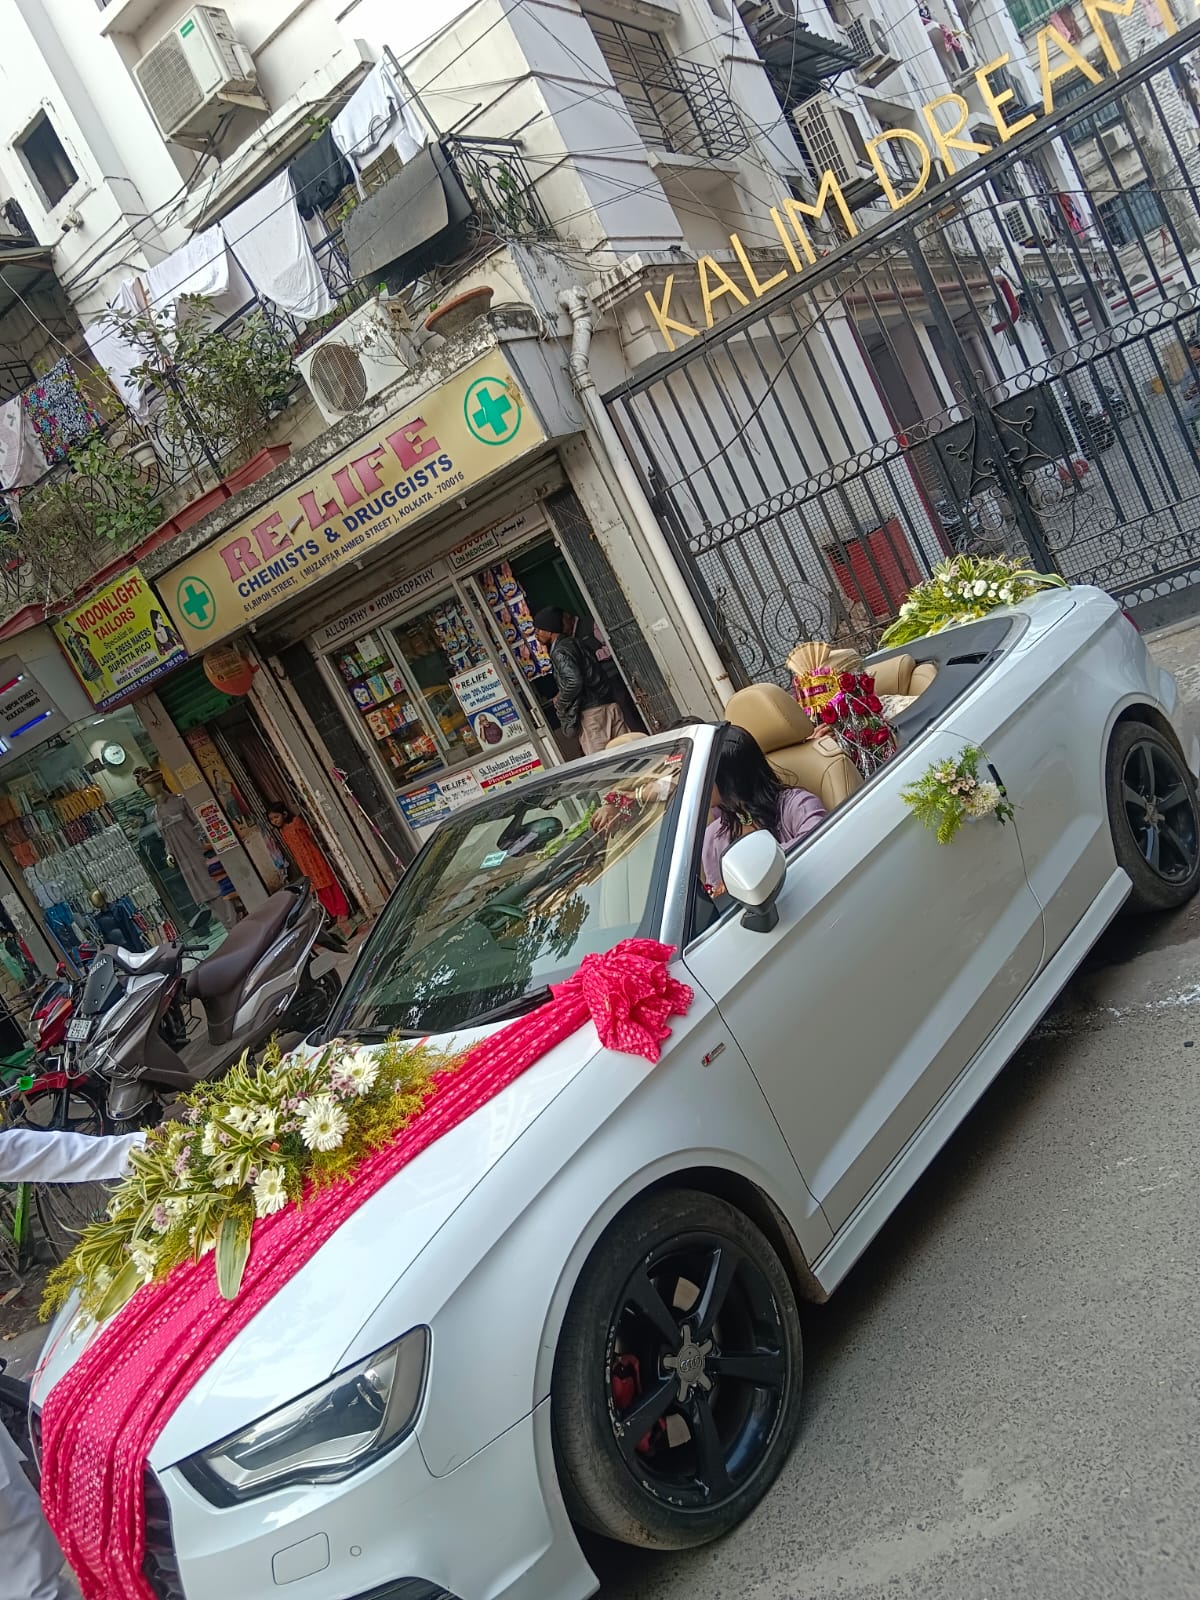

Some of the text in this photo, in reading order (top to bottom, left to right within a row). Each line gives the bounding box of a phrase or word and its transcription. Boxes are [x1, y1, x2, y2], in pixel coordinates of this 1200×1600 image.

[644, 0, 1179, 352] KALIM DREAM
[219, 417, 441, 583] RE-LIFE
[238, 454, 453, 597] CHEMISTS & DRUGGISTS
[270, 576, 298, 597] STREET,
[341, 535, 365, 554] AHMED
[398, 491, 433, 517] KOLKATA
[436, 471, 464, 494] 700016
[455, 538, 494, 564] ON MEDICINE
[76, 576, 142, 632] MOONLIGHT
[93, 606, 136, 640] TAILORS
[325, 568, 435, 638] ALLOPATHY HOMOEOPATHY
[99, 650, 117, 667] LADIES
[115, 640, 133, 656] DRESS
[131, 627, 152, 646] MAKERS
[107, 651, 136, 673] DUPATTA
[134, 641, 151, 657] PICO
